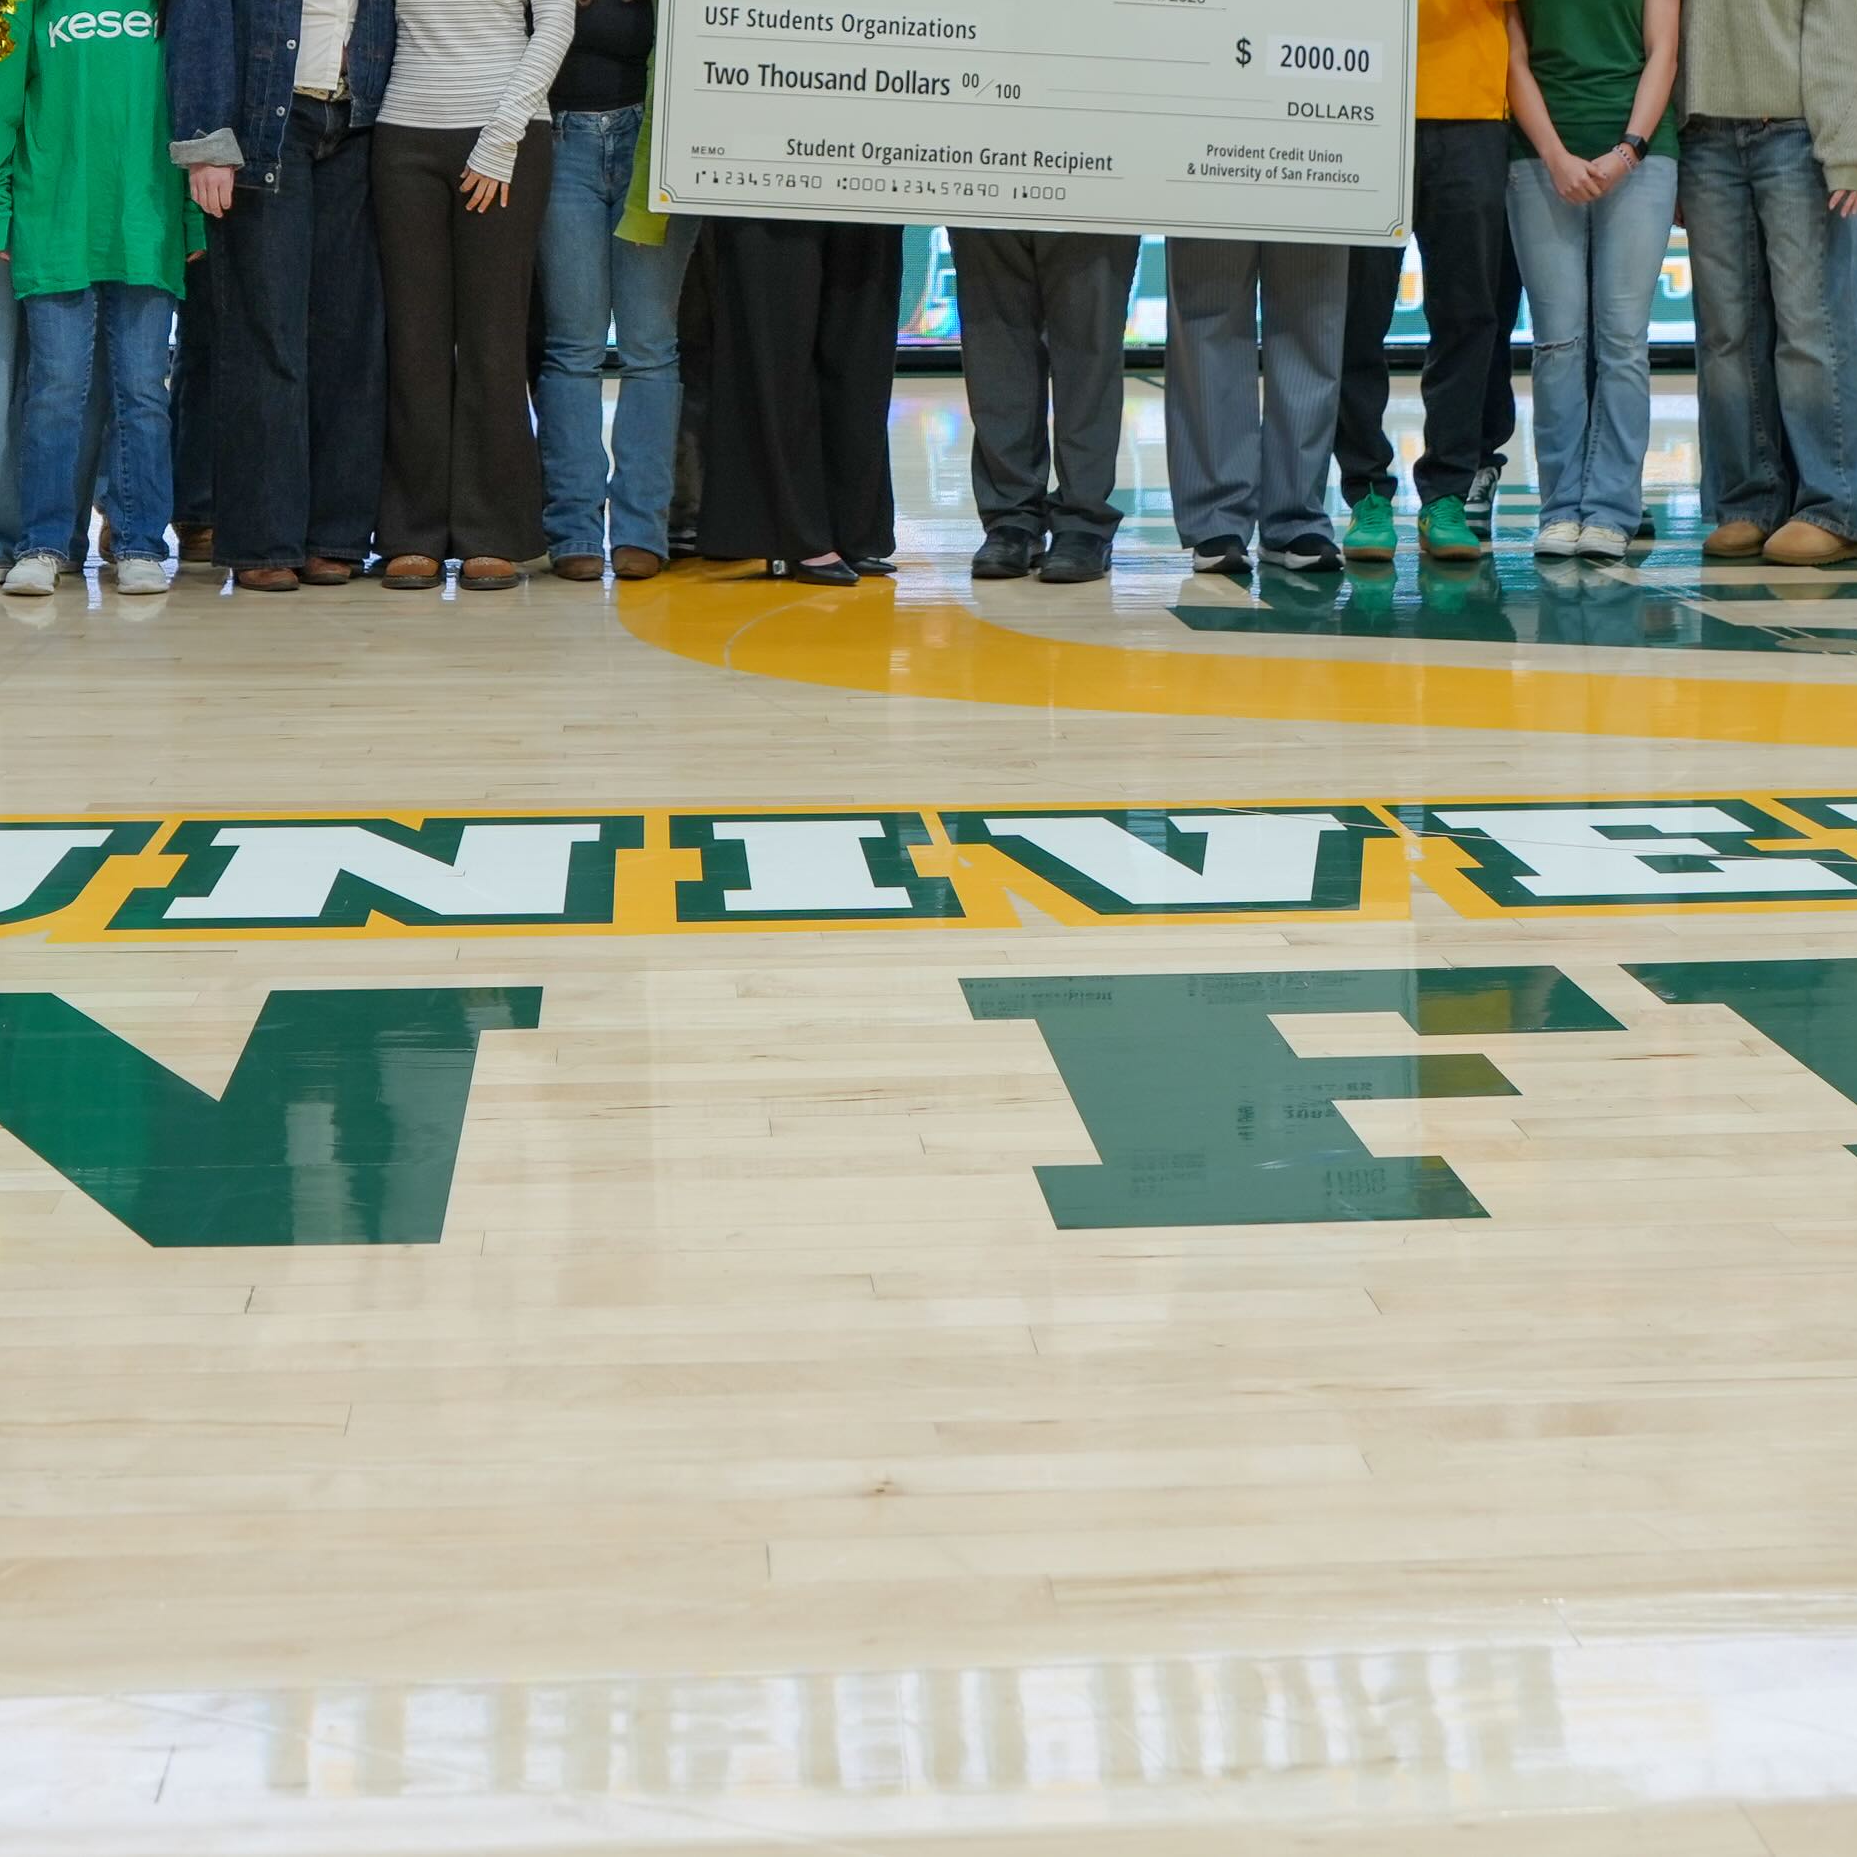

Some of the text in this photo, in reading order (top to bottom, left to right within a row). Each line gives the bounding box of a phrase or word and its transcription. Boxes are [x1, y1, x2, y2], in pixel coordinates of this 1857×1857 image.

[705, 6, 977, 40] USF Students Organizations
[1235, 37, 1370, 73] $ 2000.00
[704, 61, 749, 86] Two
[758, 63, 867, 92] Thousand
[875, 68, 950, 96] Dollars
[1287, 101, 1375, 121] DOLLARS
[691, 145, 725, 156] MEMO
[786, 138, 1113, 174] Student Organization Grant Recipient
[1206, 144, 1343, 163] Provident Credit Union
[1187, 162, 1360, 184] & University of San Francisco
